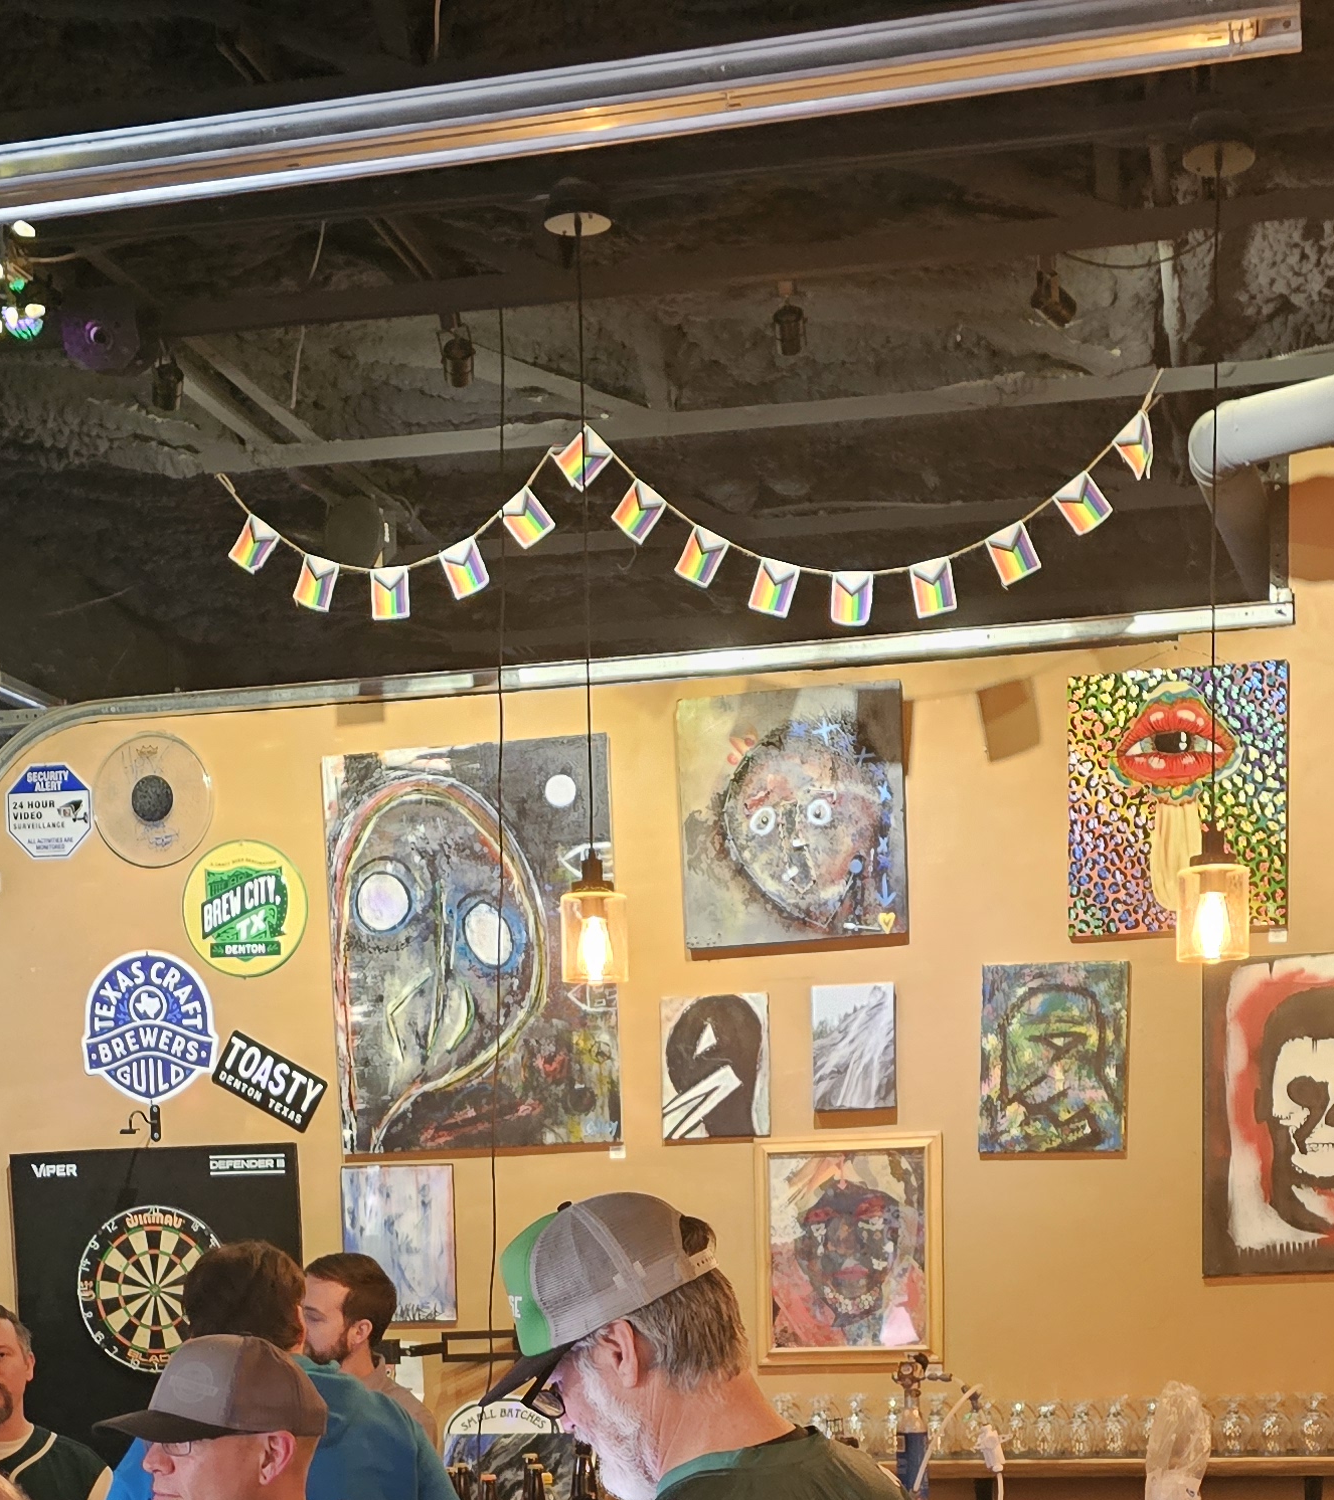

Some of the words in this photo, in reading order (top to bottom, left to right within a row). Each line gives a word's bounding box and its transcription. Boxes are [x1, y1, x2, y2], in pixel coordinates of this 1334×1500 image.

[27, 770, 69, 783] SECURITY
[34, 781, 62, 792] ALERT
[12, 801, 24, 809] 24
[27, 800, 55, 809] HOUR
[13, 811, 43, 820] VIDEO
[13, 821, 65, 830] SURVEILLANCE
[203, 886, 241, 933] BREW
[236, 909, 266, 942] TX
[224, 943, 266, 955] DENTON
[94, 960, 146, 1031] TEXAS
[150, 961, 203, 1030] CRAFT
[98, 1027, 199, 1064] BREWERS
[116, 1058, 185, 1095] GUILD
[225, 1036, 324, 1113] TOASTY
[218, 1070, 263, 1103] DENTON
[268, 1097, 303, 1125] TEXAS
[209, 1159, 275, 1170] DEFENDER
[127, 1348, 171, 1363] BLAD
[460, 1409, 497, 1431] SMALL
[499, 1408, 547, 1430] BATCHES
